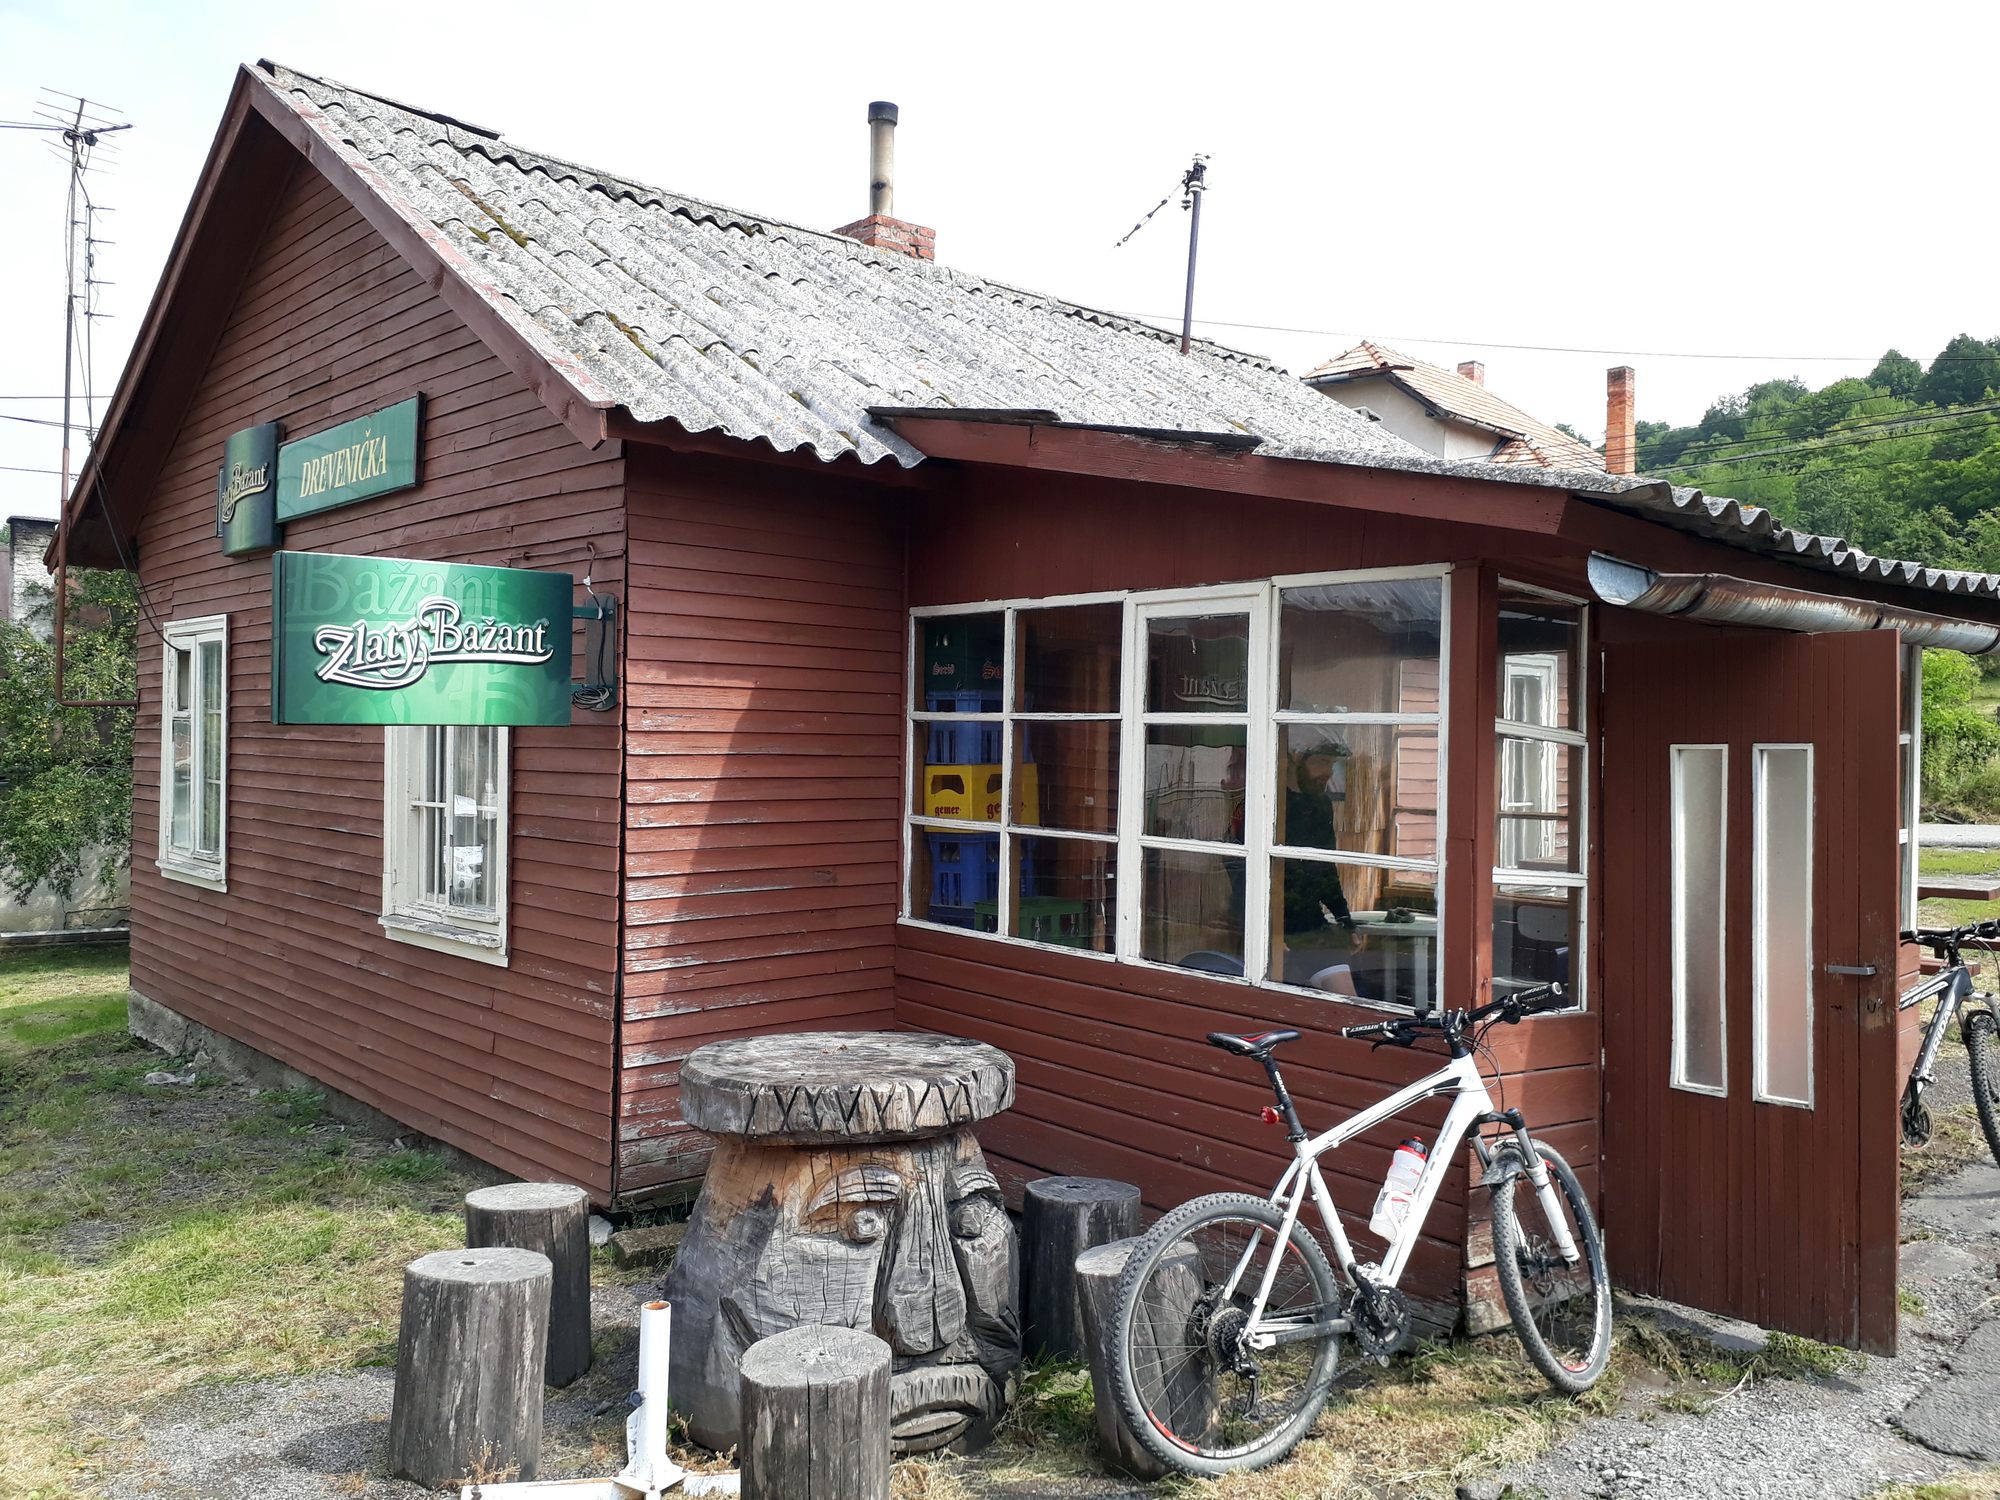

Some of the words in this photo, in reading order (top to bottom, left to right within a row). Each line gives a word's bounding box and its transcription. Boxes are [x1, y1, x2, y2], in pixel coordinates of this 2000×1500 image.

[300, 428, 388, 498] DREVENIČKA
[315, 620, 429, 690] Zlatý
[418, 597, 552, 658] Bažant
[934, 805, 961, 817] gemer
